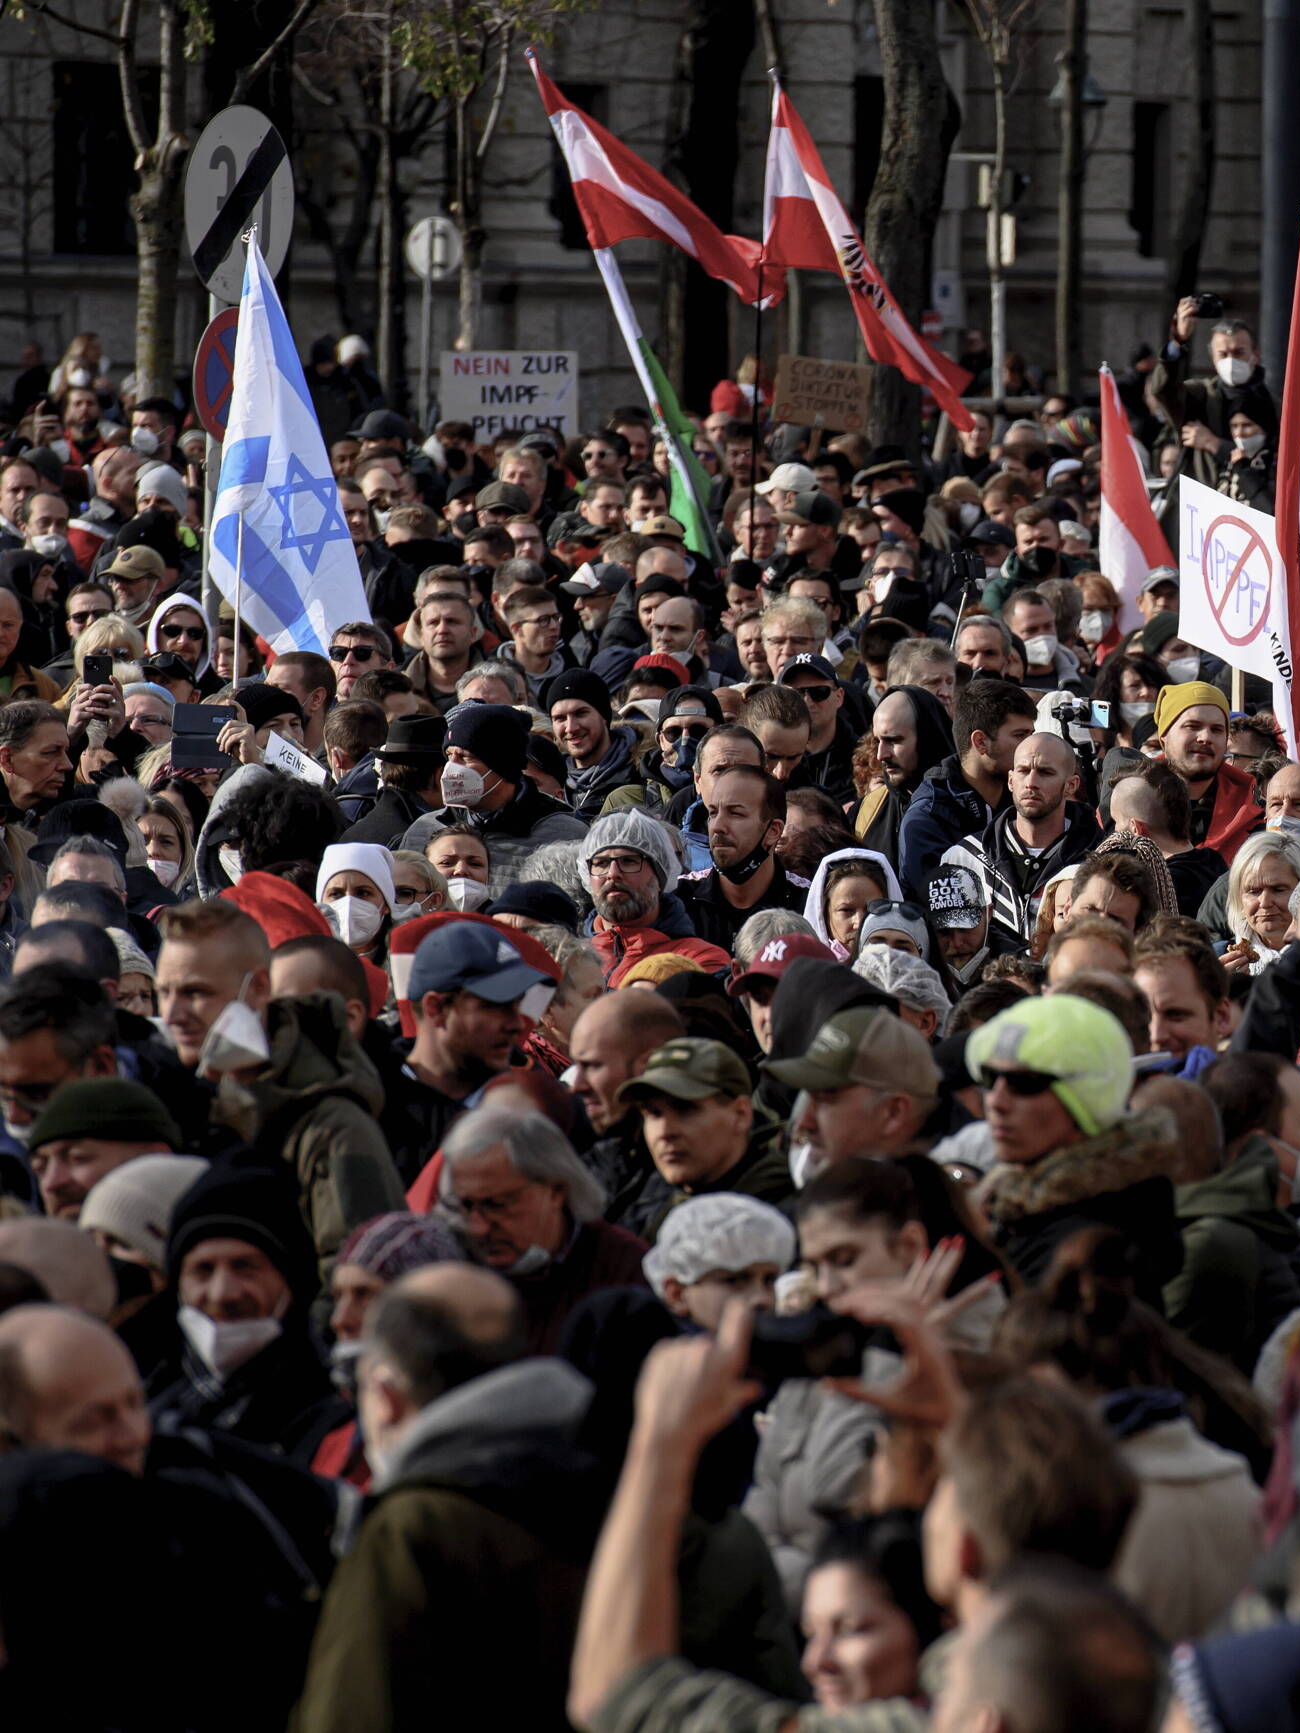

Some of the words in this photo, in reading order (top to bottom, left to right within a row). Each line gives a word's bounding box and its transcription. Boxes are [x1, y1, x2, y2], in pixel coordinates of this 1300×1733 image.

[453, 357, 510, 376] NEIN
[522, 355, 569, 375] ZUR
[279, 745, 307, 774] KEINE
[929, 877, 960, 890] I'VE
[929, 886, 960, 898] GOT
[930, 899, 965, 912] POWDER
